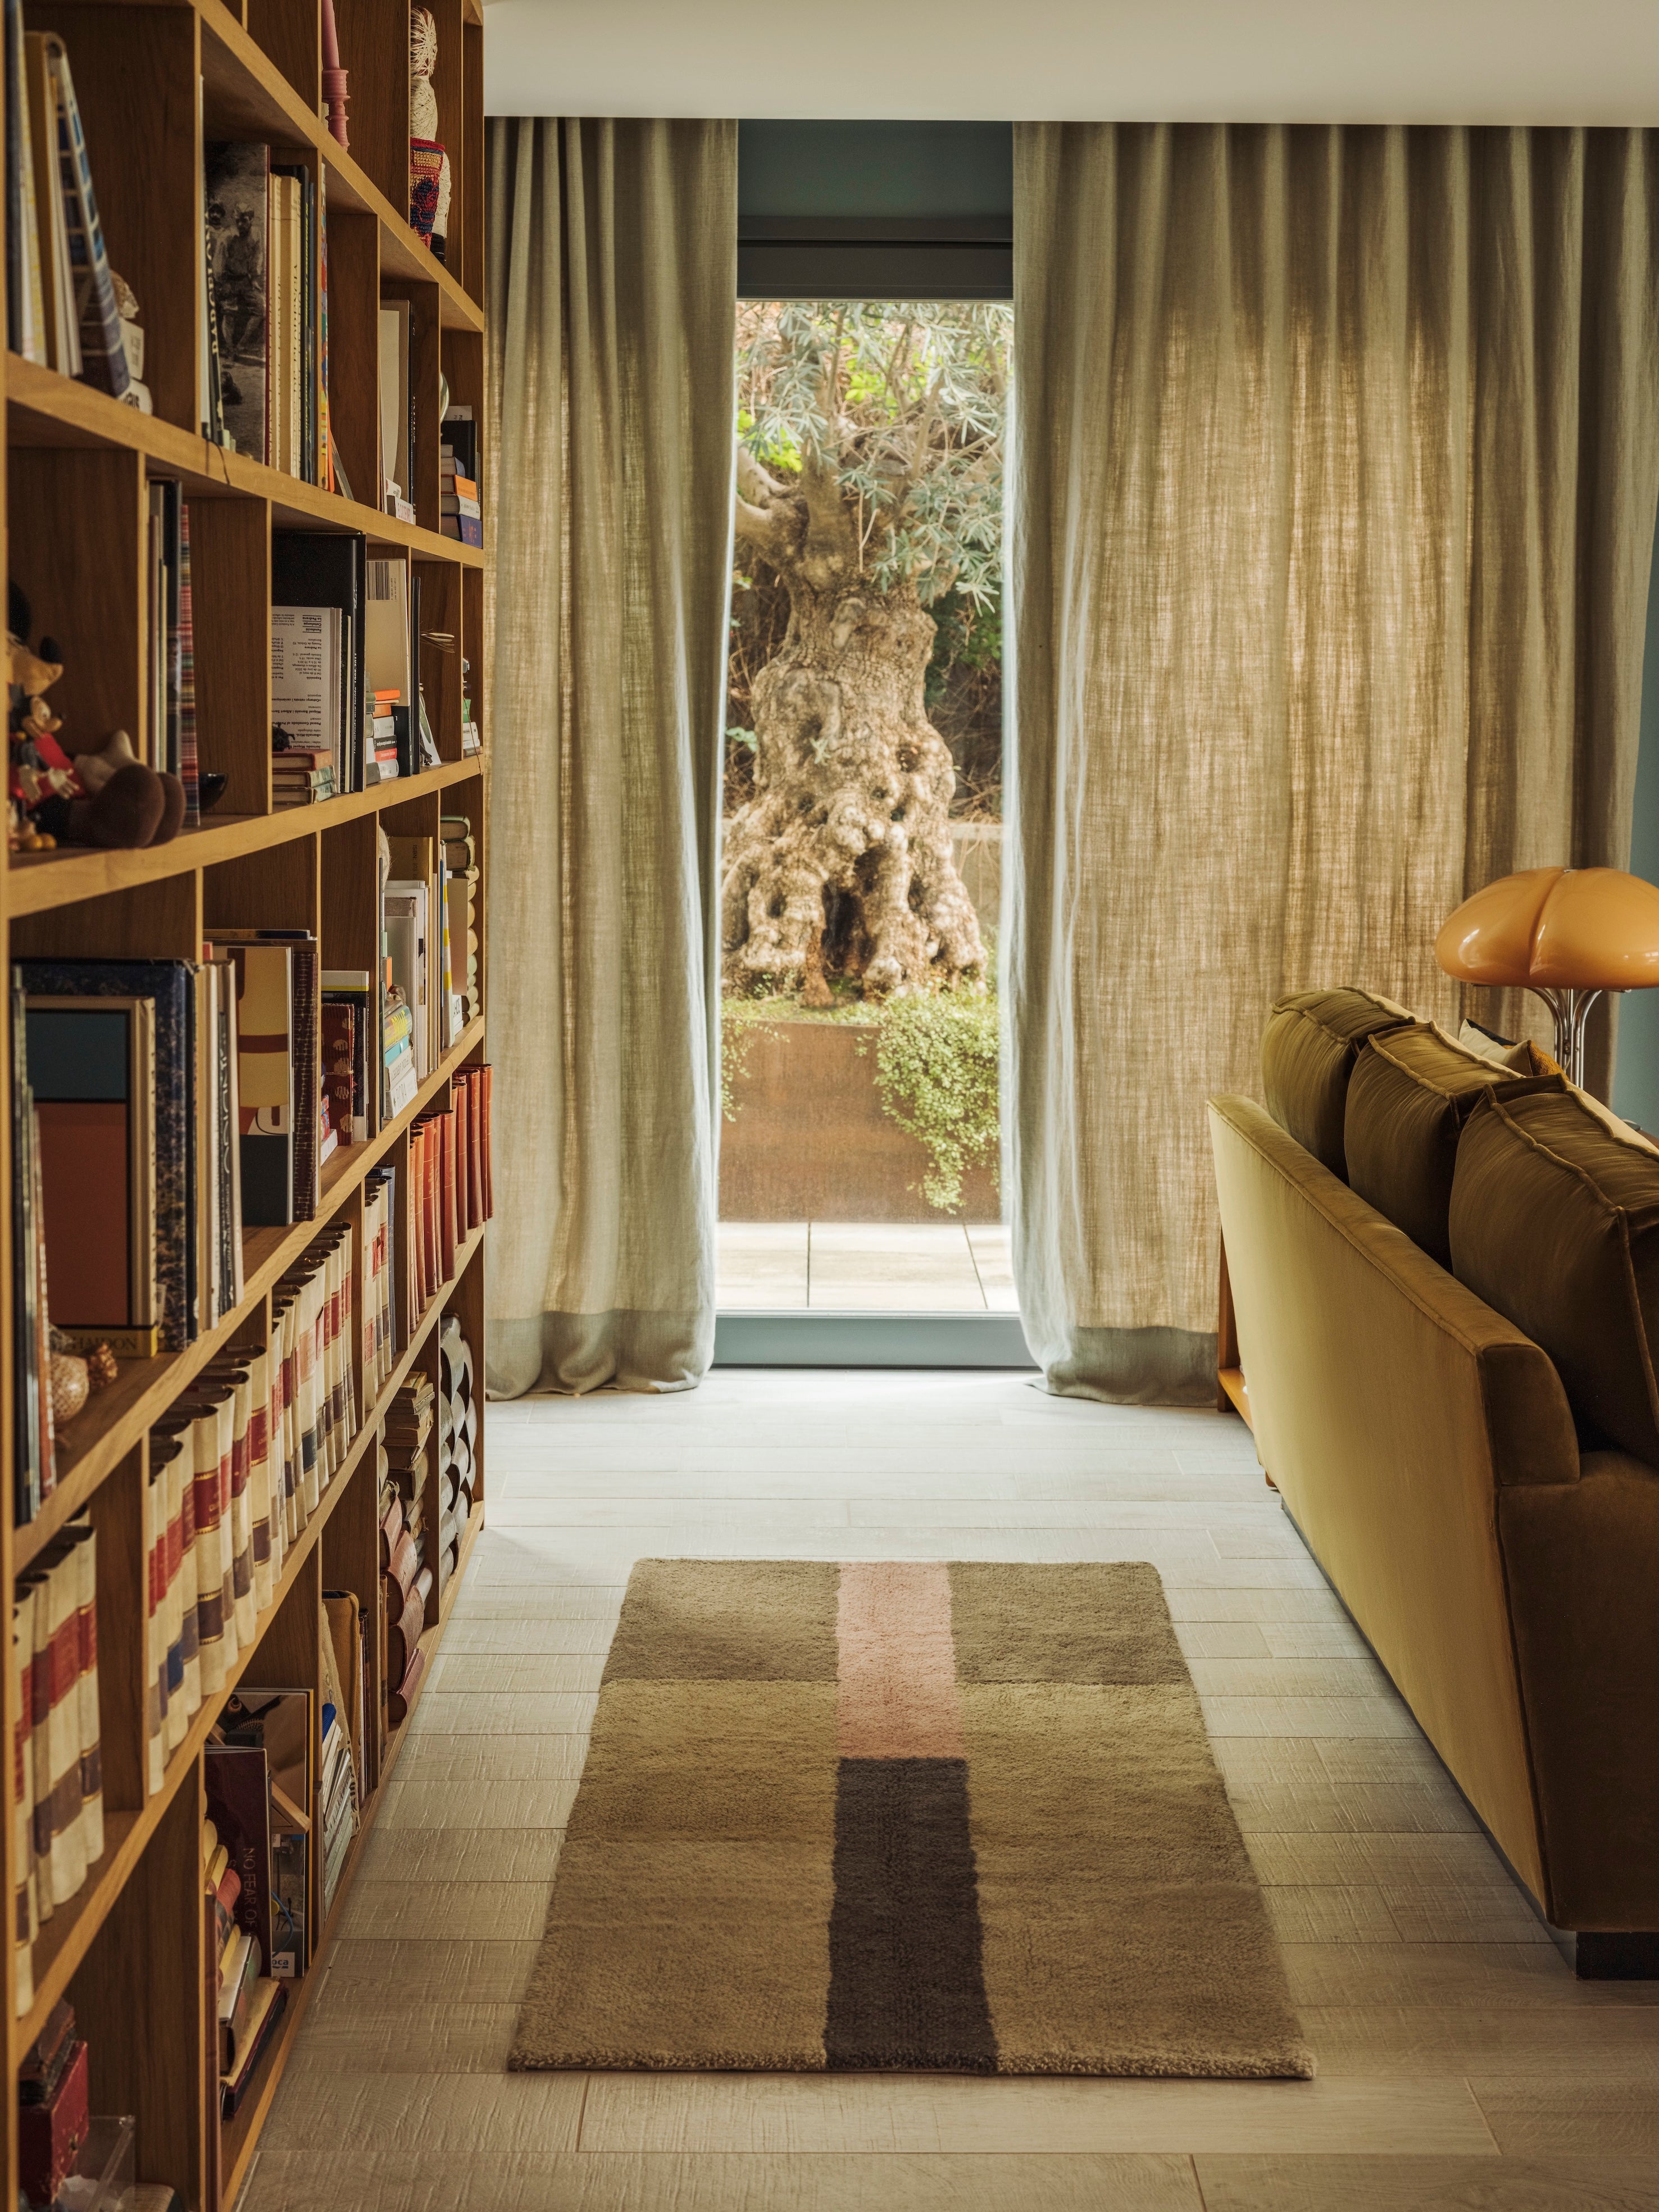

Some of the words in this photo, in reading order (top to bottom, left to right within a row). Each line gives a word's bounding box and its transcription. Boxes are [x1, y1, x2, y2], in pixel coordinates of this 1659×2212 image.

[243, 1847, 256, 1870] NO
[243, 1873, 256, 1905] FEAR
[244, 1909, 257, 1928] OF
